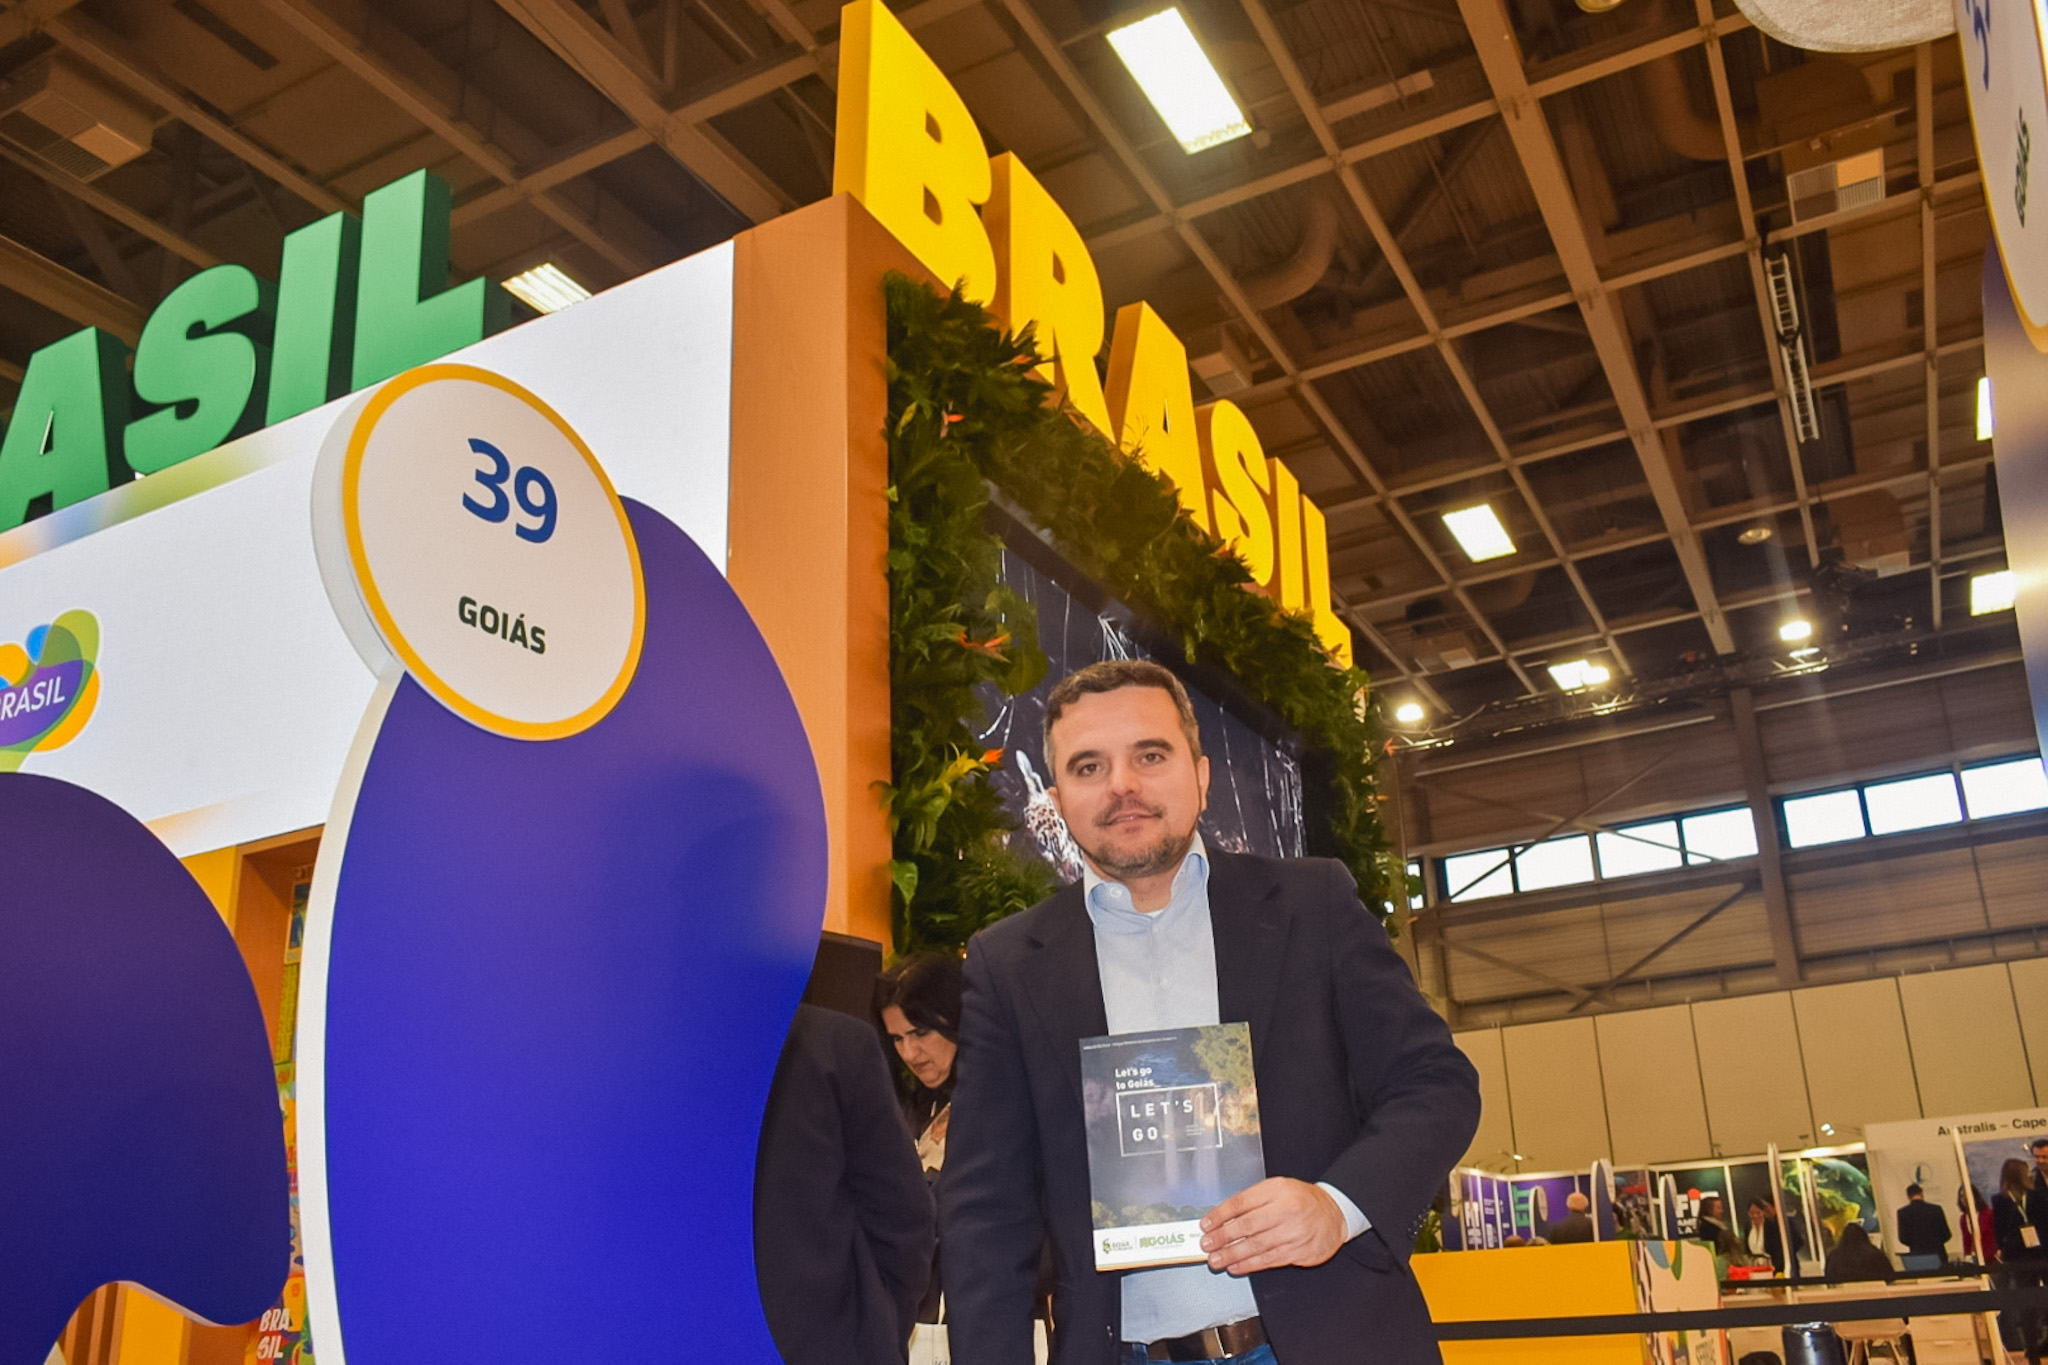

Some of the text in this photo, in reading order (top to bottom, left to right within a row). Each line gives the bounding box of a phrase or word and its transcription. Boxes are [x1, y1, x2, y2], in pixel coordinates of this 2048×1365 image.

[835, 0, 1352, 669] BRASIL
[462, 438, 557, 543] 39
[458, 595, 546, 655] GOIÁS
[0, 676, 65, 722] RASIL
[1115, 1067, 1152, 1078] Let's go
[1115, 1081, 1126, 1090] to
[1130, 1099, 1193, 1118] LET'S
[2012, 1117, 2047, 1129] Cape
[1148, 1232, 1185, 1247] GOIÁS
[260, 1308, 290, 1332] BRA
[257, 1335, 284, 1360] SIL
